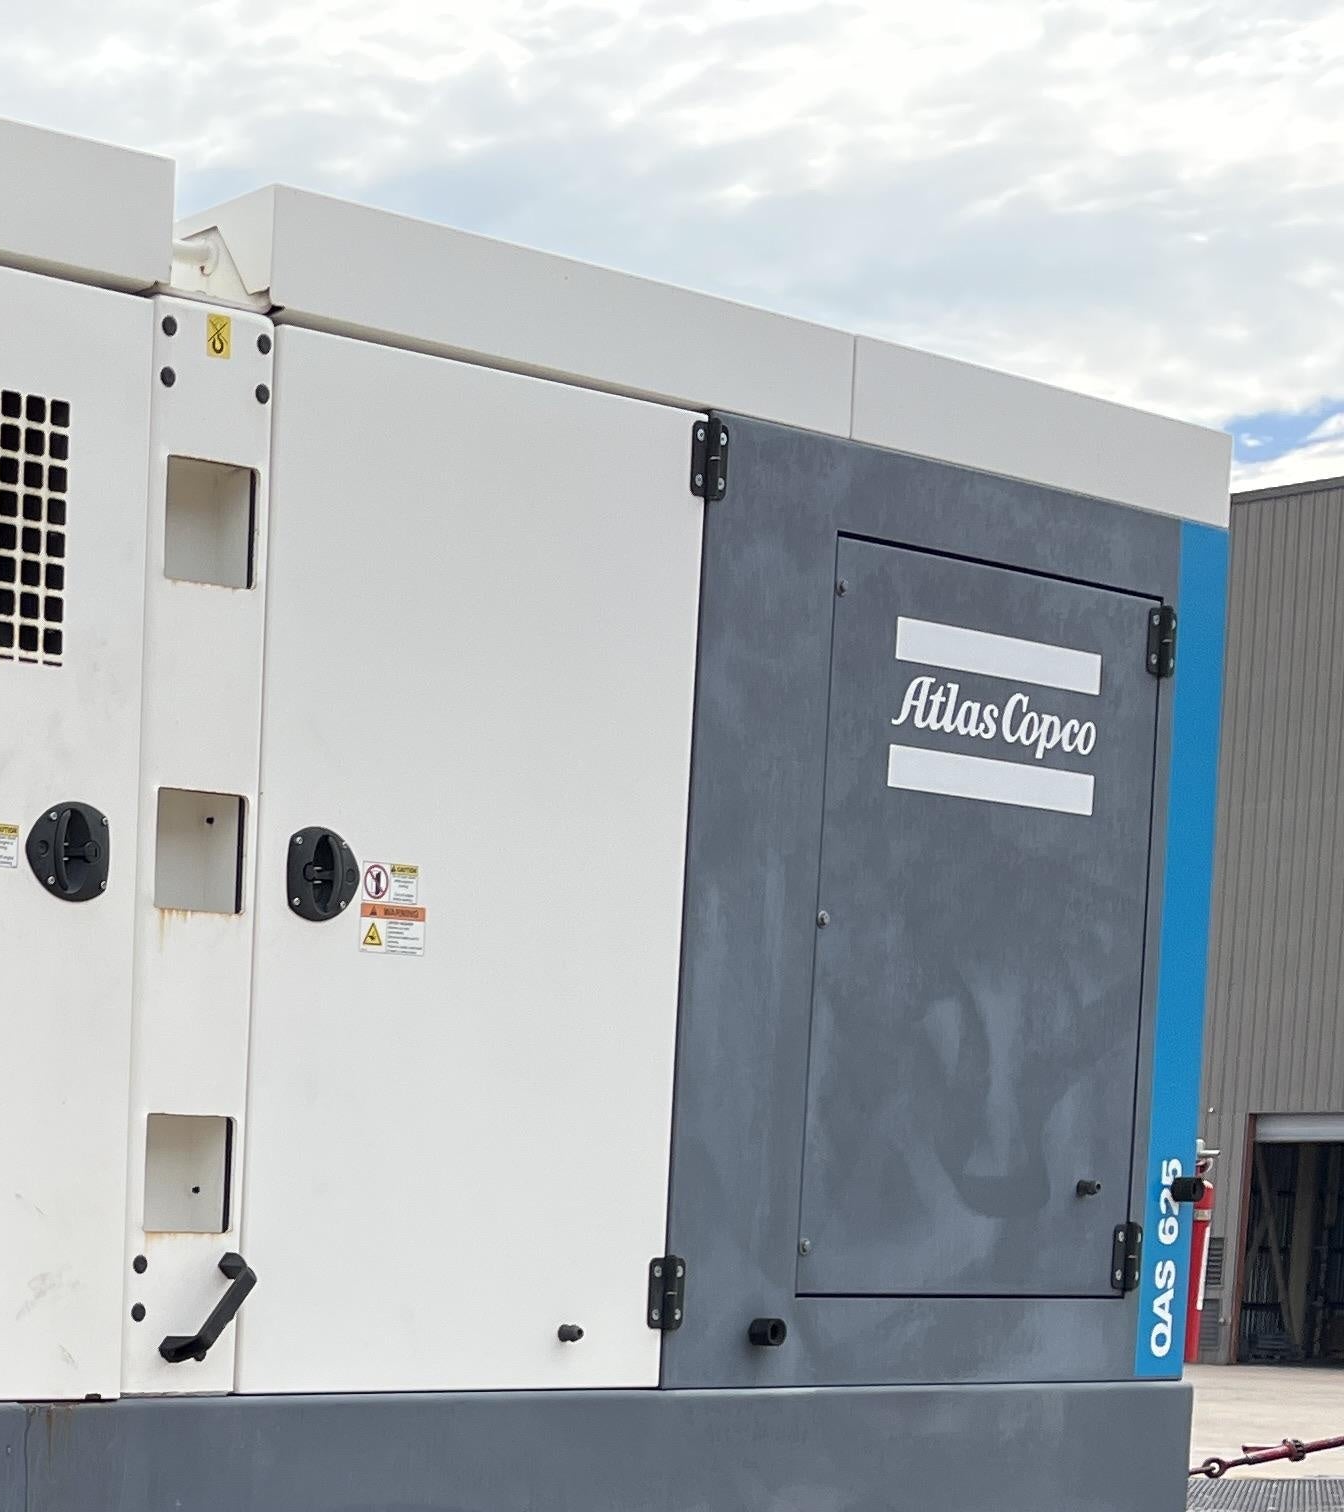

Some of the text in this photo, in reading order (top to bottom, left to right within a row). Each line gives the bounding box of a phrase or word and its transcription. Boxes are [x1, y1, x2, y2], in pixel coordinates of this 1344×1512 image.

[891, 676, 1097, 760] Atlas Copco
[1150, 1259, 1176, 1358] QAS
